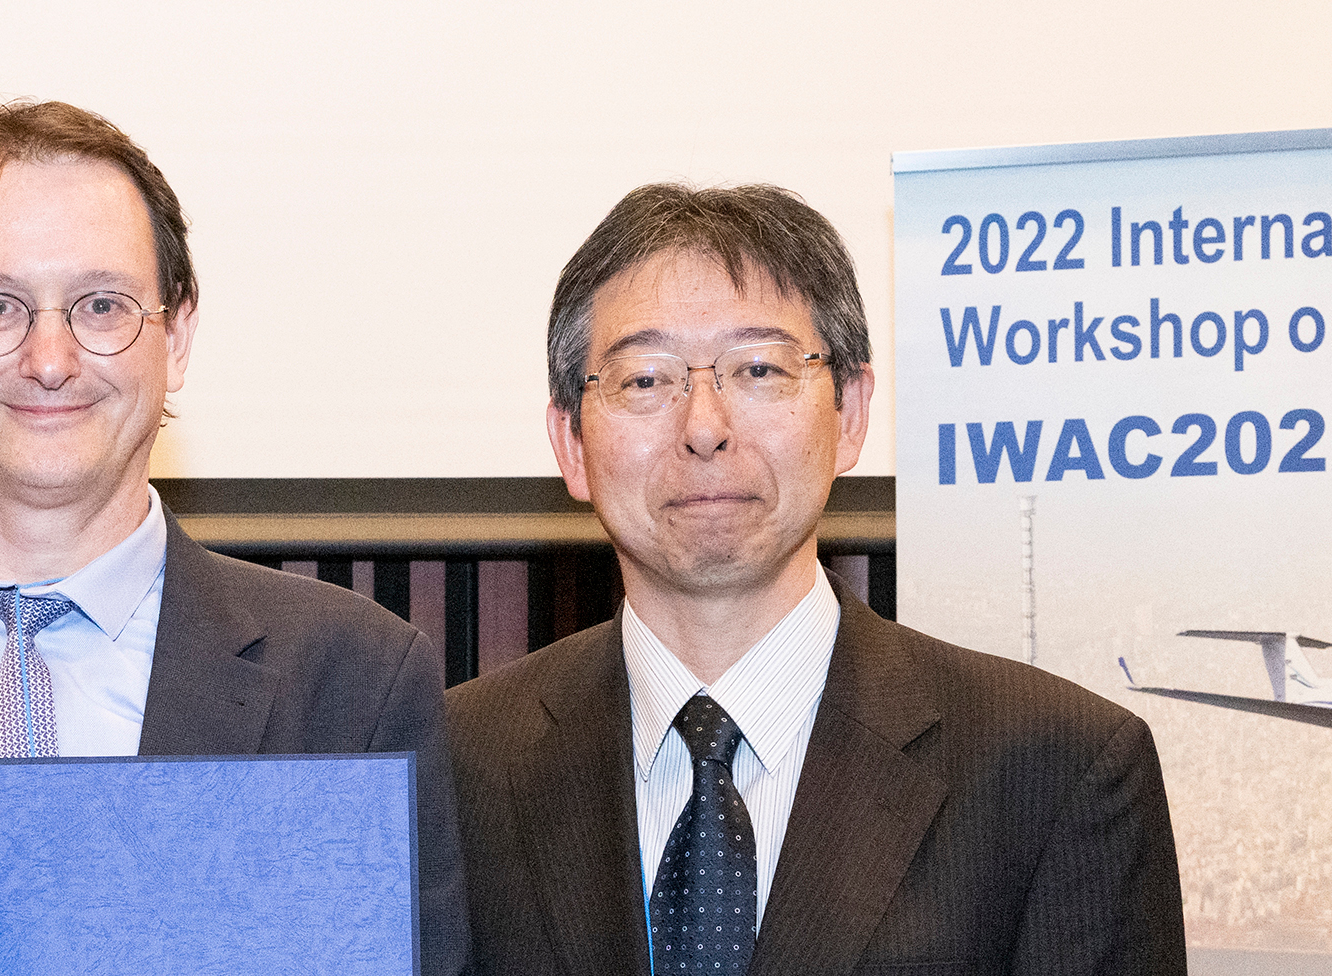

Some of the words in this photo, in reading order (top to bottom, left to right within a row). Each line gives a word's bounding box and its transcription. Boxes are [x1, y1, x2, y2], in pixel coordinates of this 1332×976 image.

[940, 208, 1085, 276] 2022
[1110, 204, 1332, 268] Interna
[940, 298, 1269, 372] Workshop
[1288, 305, 1326, 357] o
[938, 407, 1327, 486] IWAC202
